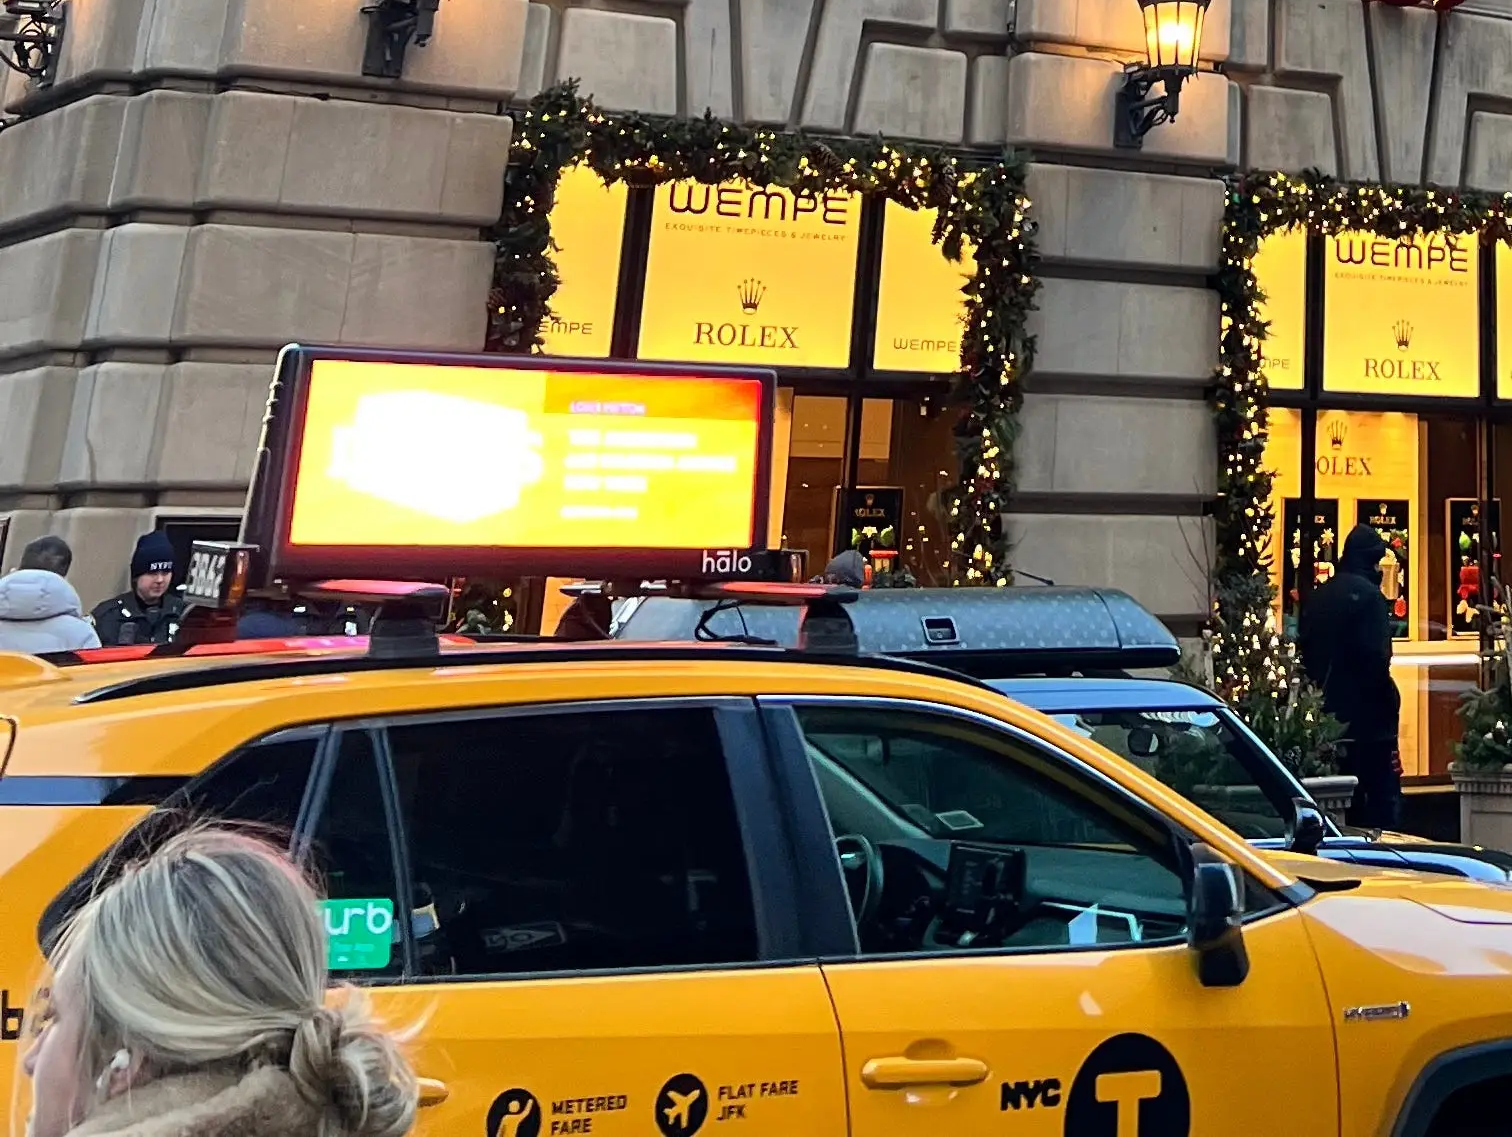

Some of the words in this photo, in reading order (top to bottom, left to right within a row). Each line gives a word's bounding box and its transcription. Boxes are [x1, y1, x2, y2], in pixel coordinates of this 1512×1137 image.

[669, 183, 848, 225] WEMPE
[1336, 238, 1468, 272] WEMPE
[538, 320, 593, 335] EMPE
[693, 322, 800, 349] ROLEX
[893, 337, 957, 352] WEMPE
[1364, 357, 1441, 381] ROLEX
[1316, 455, 1372, 476] OLEX
[325, 902, 392, 936] urb
[717, 1083, 756, 1101] FLAT
[760, 1079, 799, 1098] FARE
[1001, 1078, 1061, 1111] NYC
[551, 1094, 628, 1115] METERED
[716, 1104, 747, 1121] JFK
[551, 1117, 593, 1136] FARE
